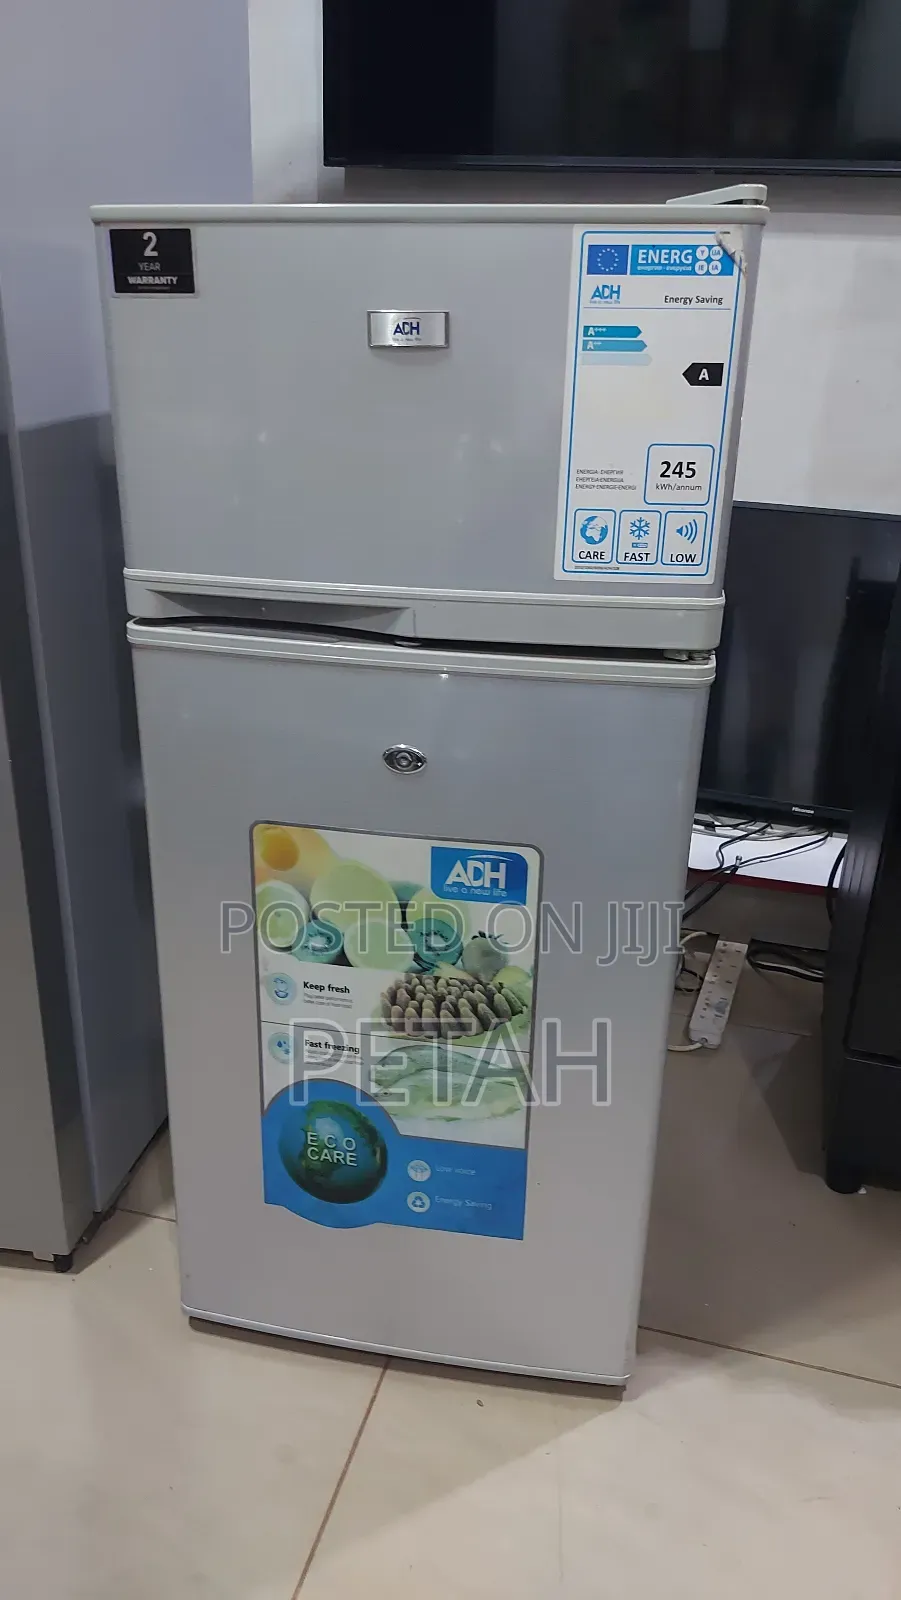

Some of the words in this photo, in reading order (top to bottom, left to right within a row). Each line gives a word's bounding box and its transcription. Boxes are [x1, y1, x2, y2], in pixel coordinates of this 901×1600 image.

[142, 231, 159, 257] 2
[637, 249, 693, 264] ENERG
[138, 262, 161, 272] YEAR
[127, 276, 178, 285] WARRANTY
[590, 284, 621, 300] ADH
[664, 295, 693, 305] Energy
[695, 295, 723, 305] Saving
[393, 321, 420, 336] ADH
[698, 368, 710, 381] A
[659, 460, 697, 479] 245
[655, 483, 703, 491] kWh/annum
[578, 550, 606, 560] CARE
[623, 552, 651, 562] FAST
[670, 553, 697, 563] LOW
[445, 859, 507, 889] ADH
[303, 981, 325, 992] Keep
[327, 983, 350, 994] fresh
[304, 1039, 322, 1049] Fast
[324, 1041, 360, 1055] freezing
[306, 1146, 358, 1167] CARE
